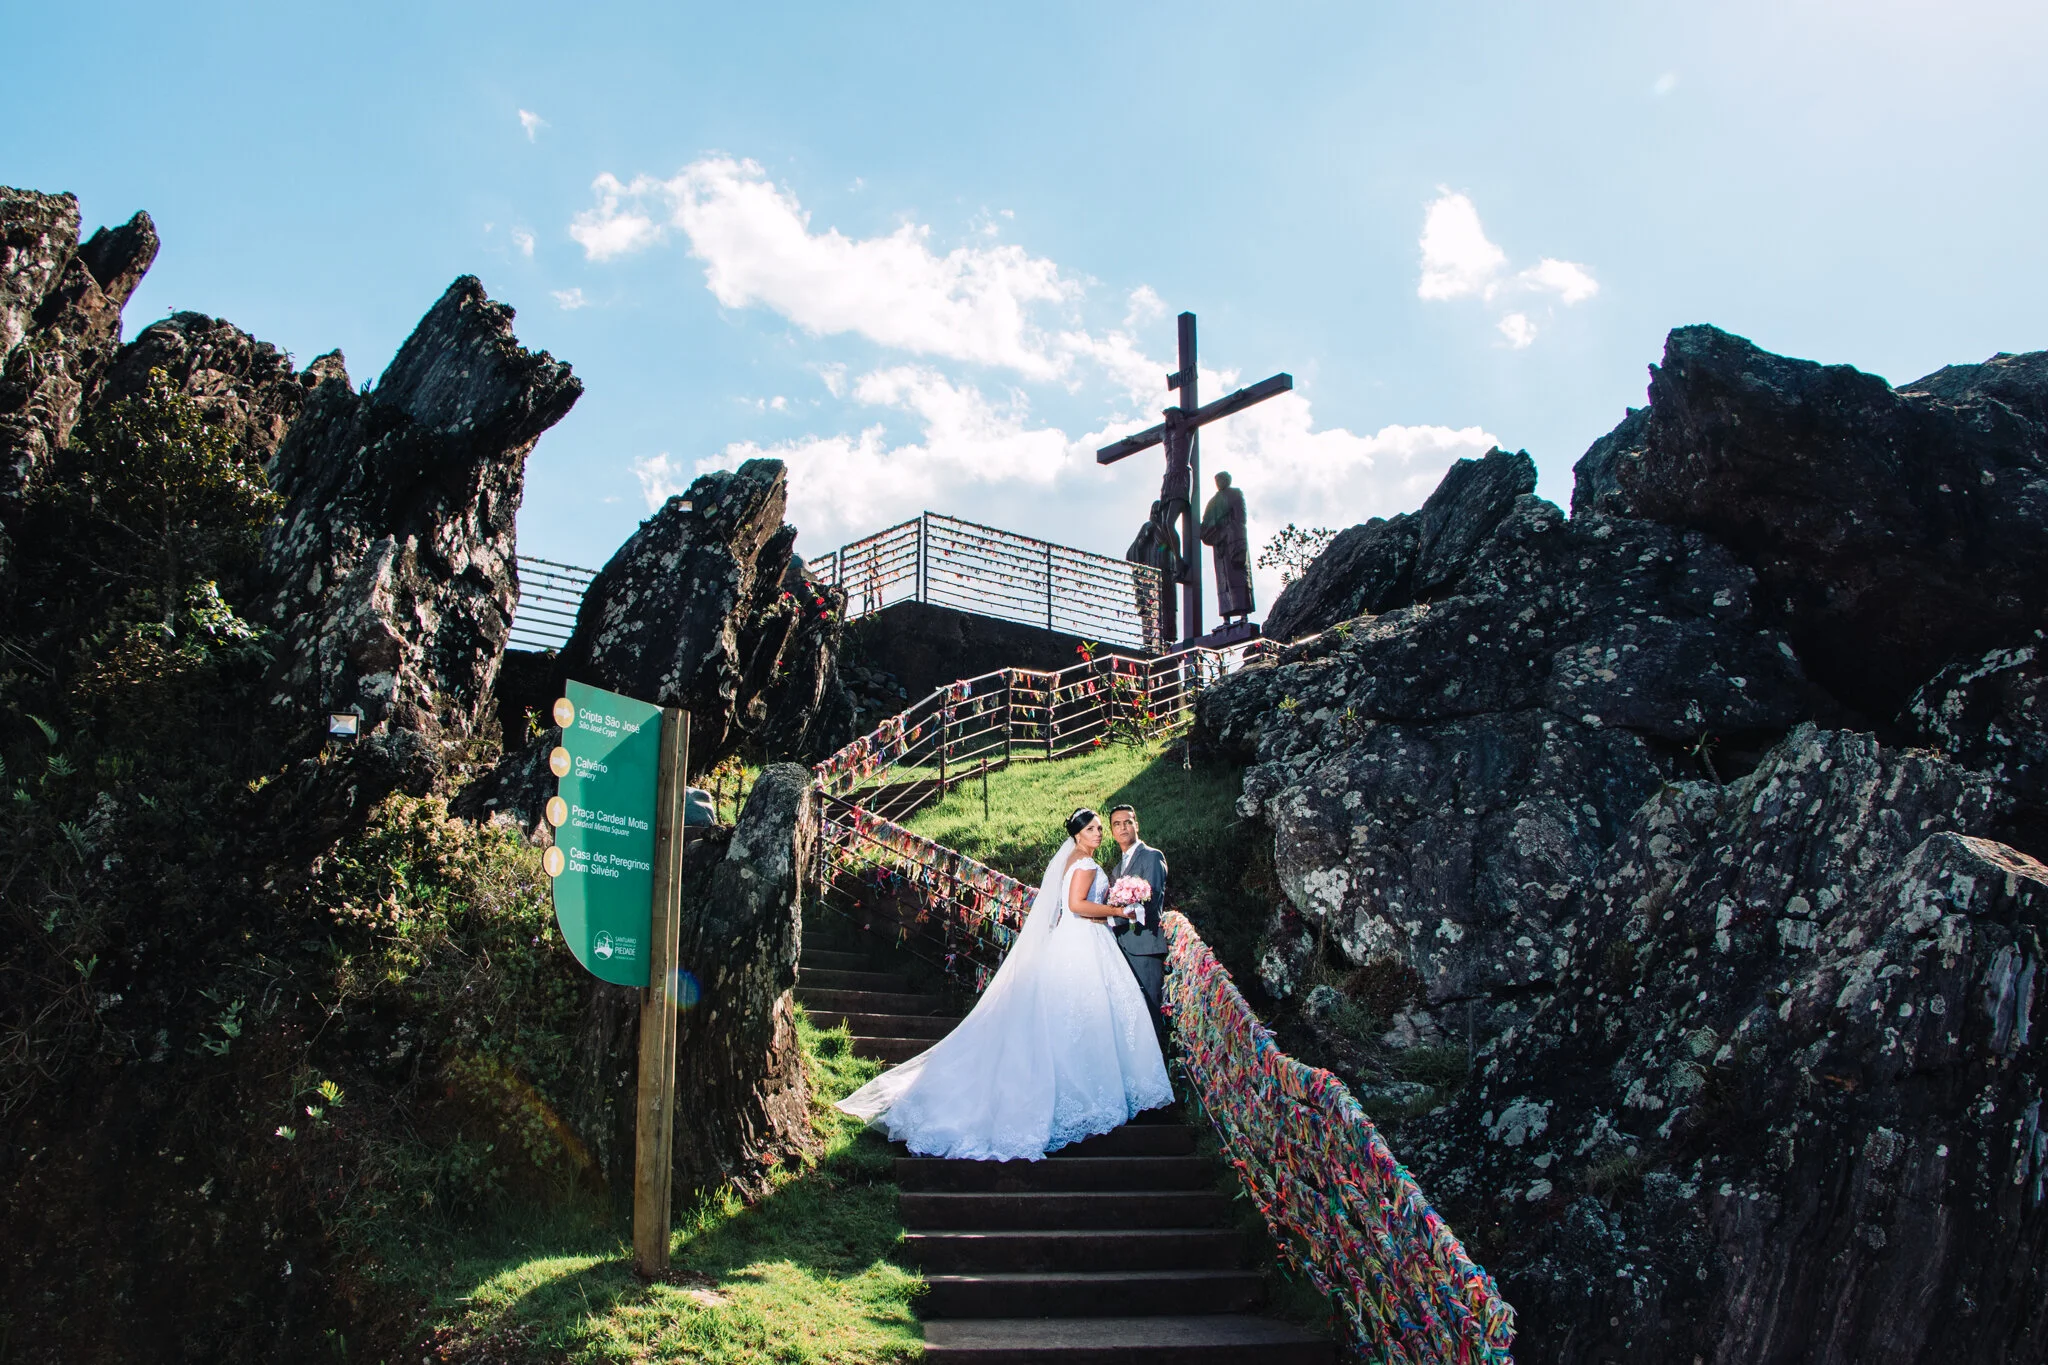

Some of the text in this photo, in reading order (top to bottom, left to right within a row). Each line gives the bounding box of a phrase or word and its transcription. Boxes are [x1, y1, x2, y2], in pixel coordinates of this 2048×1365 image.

[578, 720, 617, 738] São José Crypt
[579, 708, 639, 734] Cripta São José
[575, 756, 608, 773] Calvário
[572, 805, 649, 831] Praça Cardeal Motta
[611, 826, 630, 837] Square
[570, 847, 650, 871] Casa dos Peregrinos
[569, 860, 620, 878] Dom Silvério
[614, 946, 635, 956] PIEDADE
